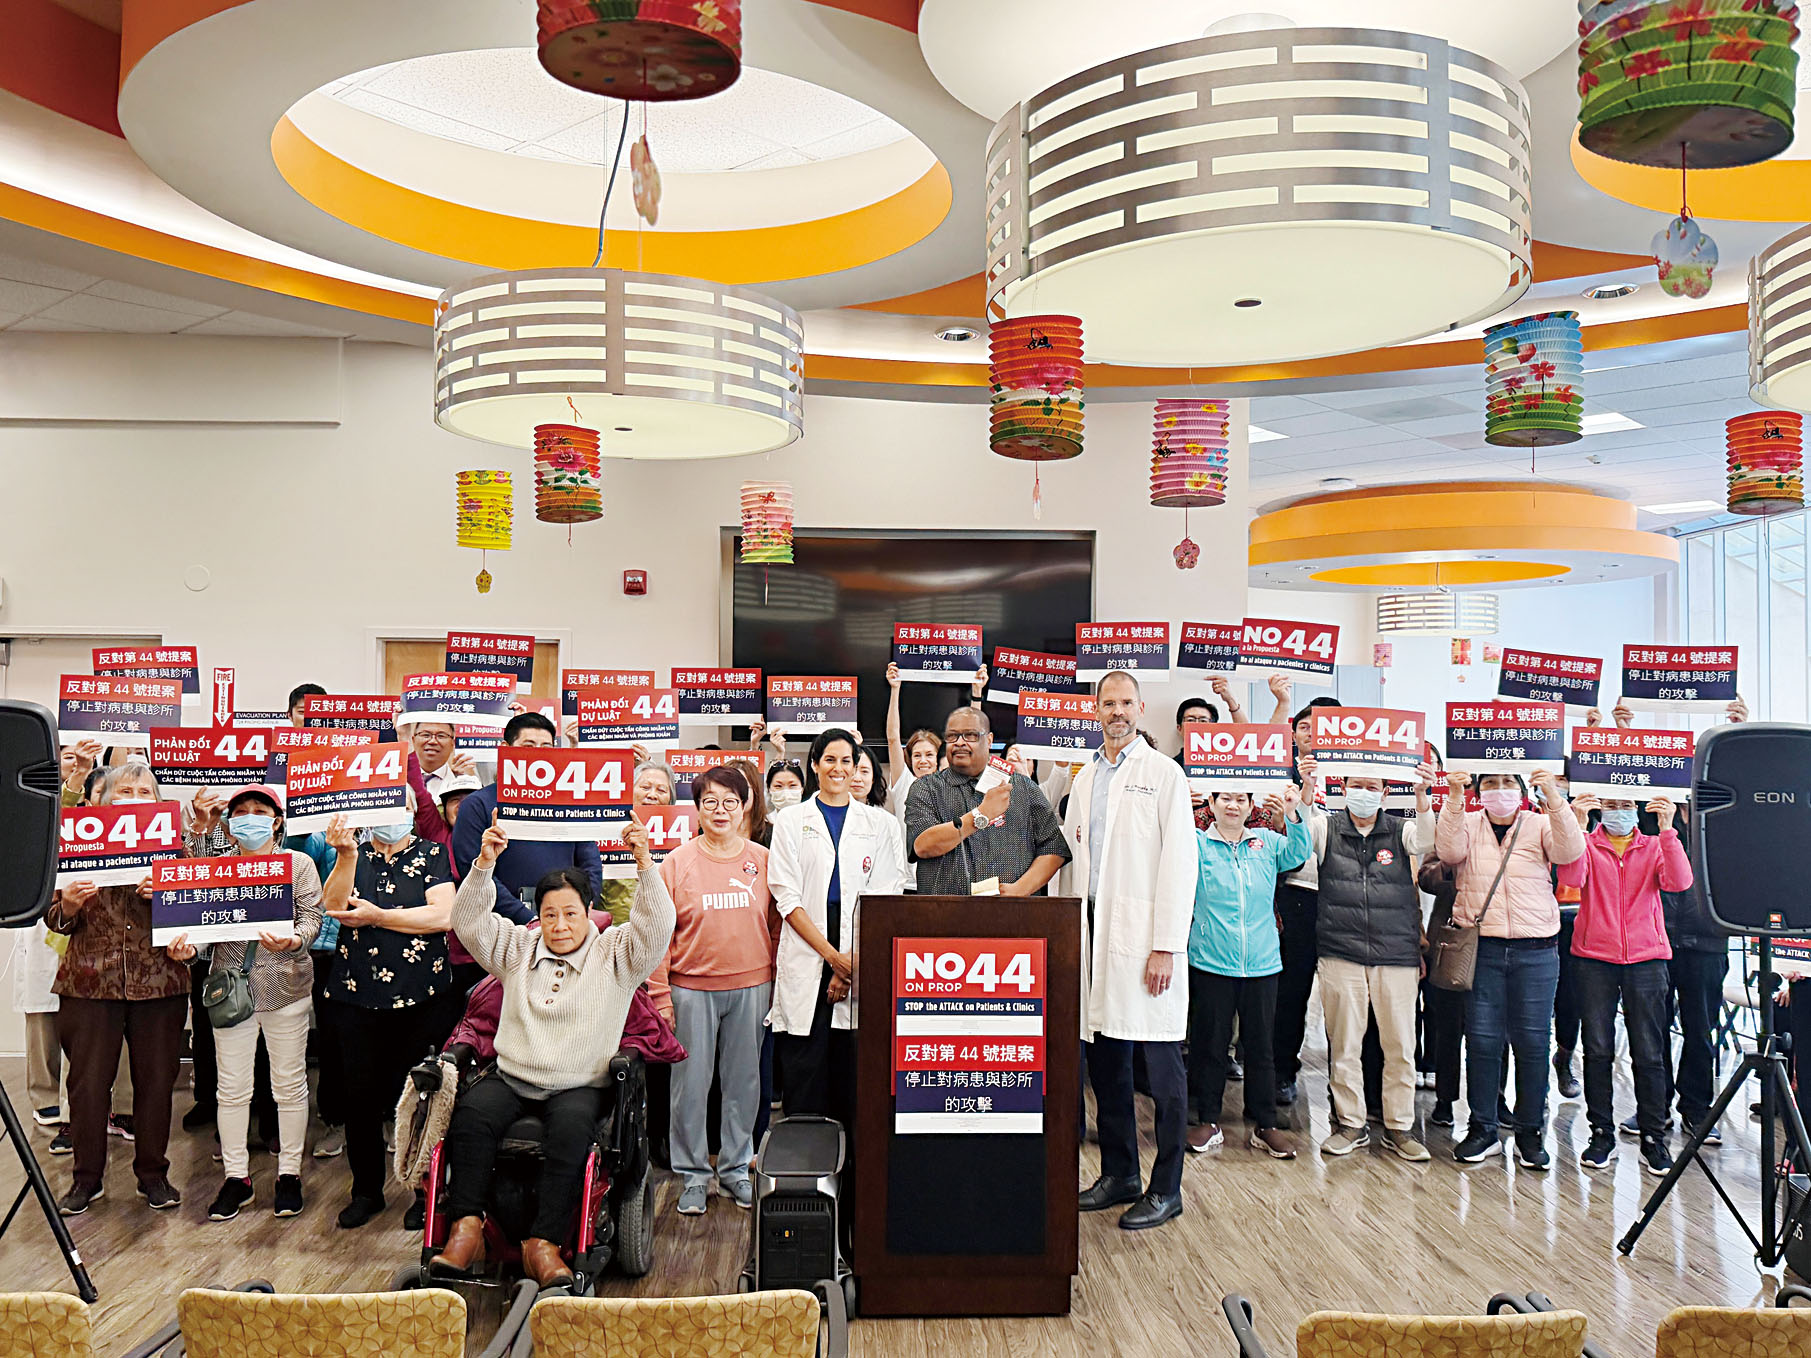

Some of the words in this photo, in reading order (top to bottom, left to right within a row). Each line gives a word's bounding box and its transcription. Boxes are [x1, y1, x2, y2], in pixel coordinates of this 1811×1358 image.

[899, 628, 931, 639] 反對第
[932, 630, 945, 639] 44
[947, 629, 978, 640] 號提案
[1081, 627, 1113, 638] 反對第
[1116, 628, 1129, 638] 44
[1131, 627, 1164, 638] 號提案
[1185, 628, 1218, 639] 反對第
[1219, 631, 1231, 639] 44
[451, 637, 480, 649] 反對第
[483, 639, 494, 648] 44
[497, 639, 529, 651] 號提案
[1243, 626, 1282, 645] NO
[1282, 629, 1333, 659] 44
[899, 644, 977, 656] 停止對病患與診所
[1081, 644, 1163, 655] 停止對病患與診所
[99, 652, 137, 664] 反對第
[139, 653, 153, 662] 44
[155, 651, 192, 664] 號提案
[451, 653, 527, 667] 停止對病患與診所
[998, 652, 1031, 666] 反對第
[1032, 659, 1043, 668] 44
[1046, 657, 1077, 671] 號提案
[1506, 653, 1542, 668] 反對第
[1544, 660, 1557, 669] 44
[1559, 661, 1597, 674] 號提案
[1627, 650, 1668, 663] 反對第
[1672, 653, 1687, 663] 44
[1690, 651, 1732, 664] 號提案
[922, 660, 953, 670] 的攻擊
[1107, 659, 1138, 669] 的攻擊
[217, 673, 231, 681] FIRE
[407, 675, 449, 687] 反對第
[451, 677, 467, 685] 44
[469, 676, 511, 687] 號提案
[567, 674, 600, 685] 反對第
[602, 676, 614, 684] 44
[617, 675, 650, 686] 號提案
[675, 673, 708, 684] 反對第
[710, 674, 722, 683] 44
[724, 673, 757, 684] 號提案
[996, 667, 1073, 685] 停止對病患與診所
[1505, 670, 1594, 690] 停止對病患與診所
[1629, 669, 1731, 683] 停止對病患與診所
[66, 681, 111, 694] 反對第
[114, 685, 130, 695] 44
[133, 684, 175, 698] 號提案
[771, 681, 803, 692] 反對第
[805, 683, 818, 691] 44
[820, 681, 852, 692] 號提案
[406, 690, 508, 702] 停止對病患與診所
[1529, 689, 1564, 702] 的攻擊
[1658, 688, 1698, 700] 的攻擊
[66, 700, 174, 717] 停止對病患與診所
[309, 700, 347, 712] 反對第
[350, 702, 364, 711] 44
[581, 699, 609, 710] PHẢN
[610, 696, 629, 709] ĐỐI
[631, 695, 676, 719] 44
[701, 704, 731, 714] 的攻擊
[772, 698, 851, 707] 停止對病患與診所
[1024, 697, 1062, 711] 反對第
[1063, 702, 1078, 711] 44
[581, 711, 596, 723] DỰ
[597, 710, 622, 722] LUẬT
[796, 712, 827, 722] 的攻擊
[1451, 708, 1494, 721] 反對第
[1497, 710, 1513, 720] 44
[1516, 708, 1558, 721] 號提案
[100, 720, 141, 731] 的攻擊
[277, 733, 314, 746] 反對第
[314, 736, 329, 746] 44
[1317, 716, 1365, 737] NO
[1365, 717, 1419, 750] 44
[1452, 728, 1558, 741] 停止對病患與診所
[154, 738, 187, 749] PHẢN
[189, 735, 211, 749] ĐỐI
[1051, 736, 1087, 748] 的攻擊
[1190, 732, 1236, 753] NO
[1235, 733, 1287, 763] 44
[1316, 737, 1332, 745] ON
[1334, 738, 1363, 746] PROP
[1577, 732, 1621, 746] 反對第
[1623, 736, 1640, 746] 44
[1643, 736, 1688, 750] 號提案
[213, 735, 269, 761] 44
[1485, 747, 1526, 759] 的攻擊
[154, 751, 171, 763] DỰ
[173, 751, 201, 764] LUẬT
[670, 755, 705, 766] 反對第
[708, 756, 721, 766] 44
[1207, 754, 1234, 762] PROP
[1578, 752, 1686, 769] 停止對病患與診所
[290, 761, 321, 776] PHẢN
[322, 755, 344, 771] ĐỐI
[346, 750, 403, 783] 44
[290, 779, 306, 793] DỰ
[306, 773, 334, 790] LUẬT
[503, 759, 556, 787] NO
[555, 761, 626, 800] 44
[1610, 772, 1651, 785] 的攻擊
[502, 788, 518, 797] ON
[521, 789, 552, 799] PROP
[1754, 792, 1796, 803] EON
[502, 806, 517, 816] STOP
[519, 807, 529, 816] the
[530, 808, 554, 817] ATTACK
[555, 810, 565, 818] on
[565, 808, 595, 818] Patients
[596, 809, 601, 817] &
[603, 808, 626, 818] Clinics
[60, 816, 104, 841] NO
[107, 812, 177, 849] 44
[65, 842, 105, 853] Propuesta
[61, 860, 69, 869] al
[70, 858, 98, 870] ataque
[105, 856, 142, 868] pacientes
[143, 858, 149, 866] y
[160, 864, 211, 882] 反對第
[214, 866, 233, 878] 44
[236, 861, 285, 878] 號提案
[161, 884, 284, 905] 停止對病患與診所
[702, 891, 750, 911] PUMA
[201, 908, 248, 925] 的攻擊
[905, 951, 966, 980] NO
[965, 953, 1036, 993] 44
[905, 982, 927, 992] ON
[928, 982, 963, 992] PROP
[904, 1002, 924, 1012] STOP
[926, 1002, 939, 1011] the
[939, 1002, 964, 1011] ATTACK
[976, 1002, 1005, 1012] Patients
[1005, 1002, 1011, 1011] &
[1012, 1002, 1036, 1012] Clinics
[904, 1044, 956, 1062] 反對第
[959, 1046, 979, 1061] 44
[982, 1044, 1036, 1062] 號提案
[904, 1071, 1033, 1088] 停止對病患與診所
[945, 1096, 993, 1113] 的攻擊
